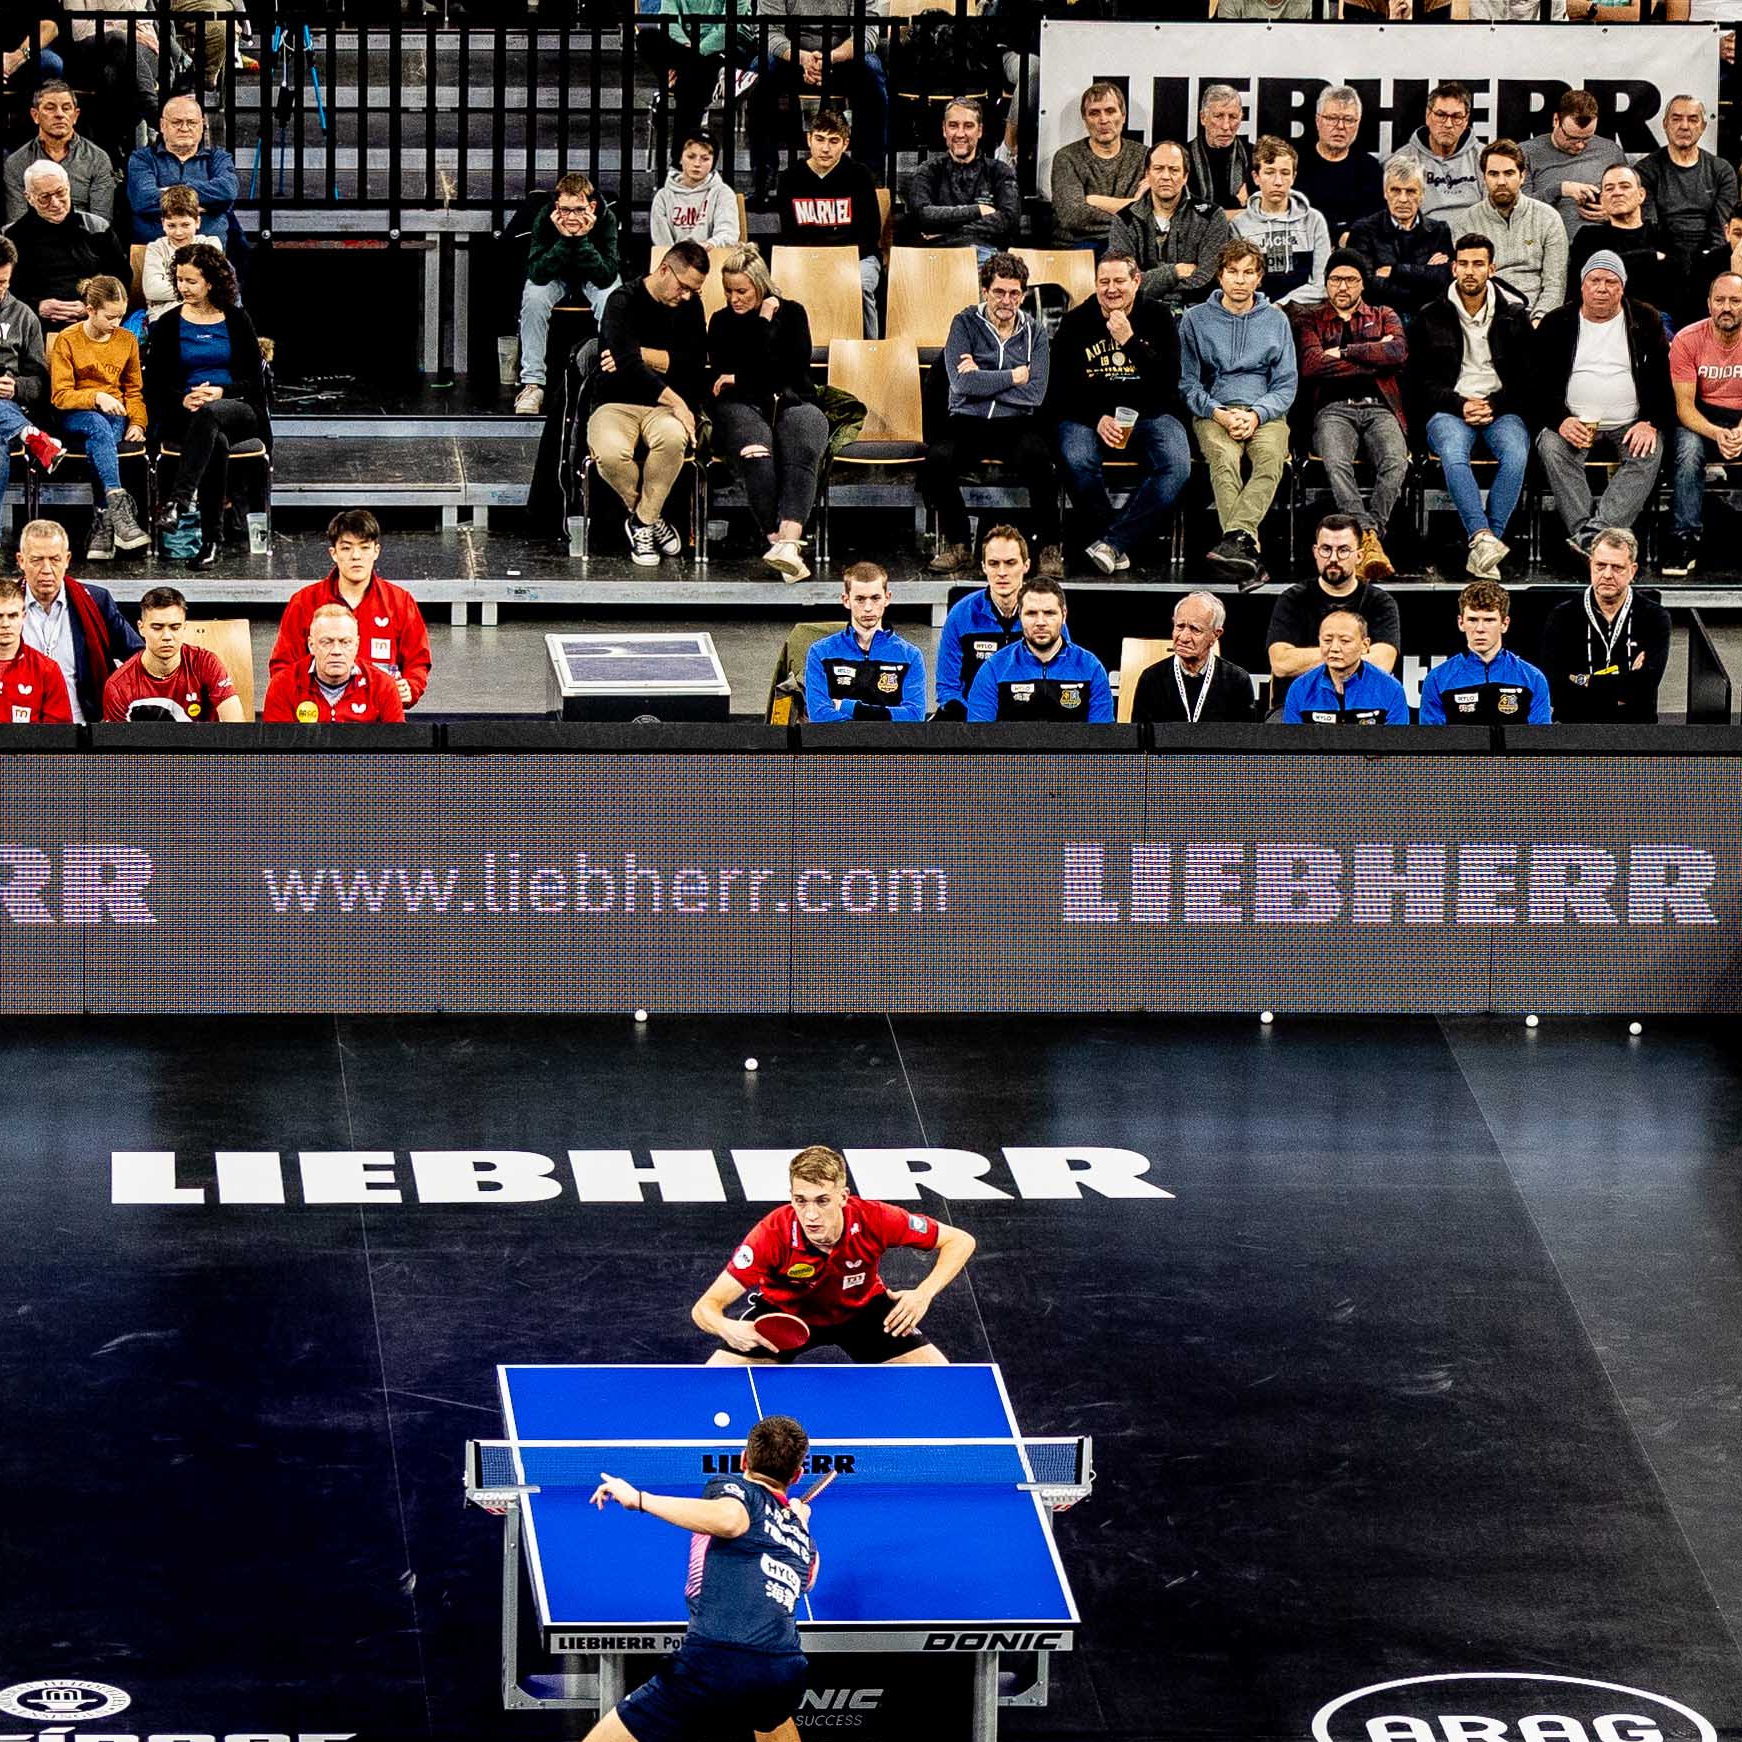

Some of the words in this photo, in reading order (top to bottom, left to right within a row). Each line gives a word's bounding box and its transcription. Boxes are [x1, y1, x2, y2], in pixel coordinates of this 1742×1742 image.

[794, 199, 850, 225] MARVEL
[263, 853, 948, 914] www.liebherr.com
[1062, 843, 1720, 925] LIEBHERR
[472, 1491, 518, 1501] DONIC
[1041, 1488, 1088, 1498] DONIC
[559, 1636, 656, 1650] LIEBHERR
[921, 1631, 1063, 1652] DONIC
[797, 1688, 884, 1710] NIC
[794, 1714, 864, 1727] SUCCESS
